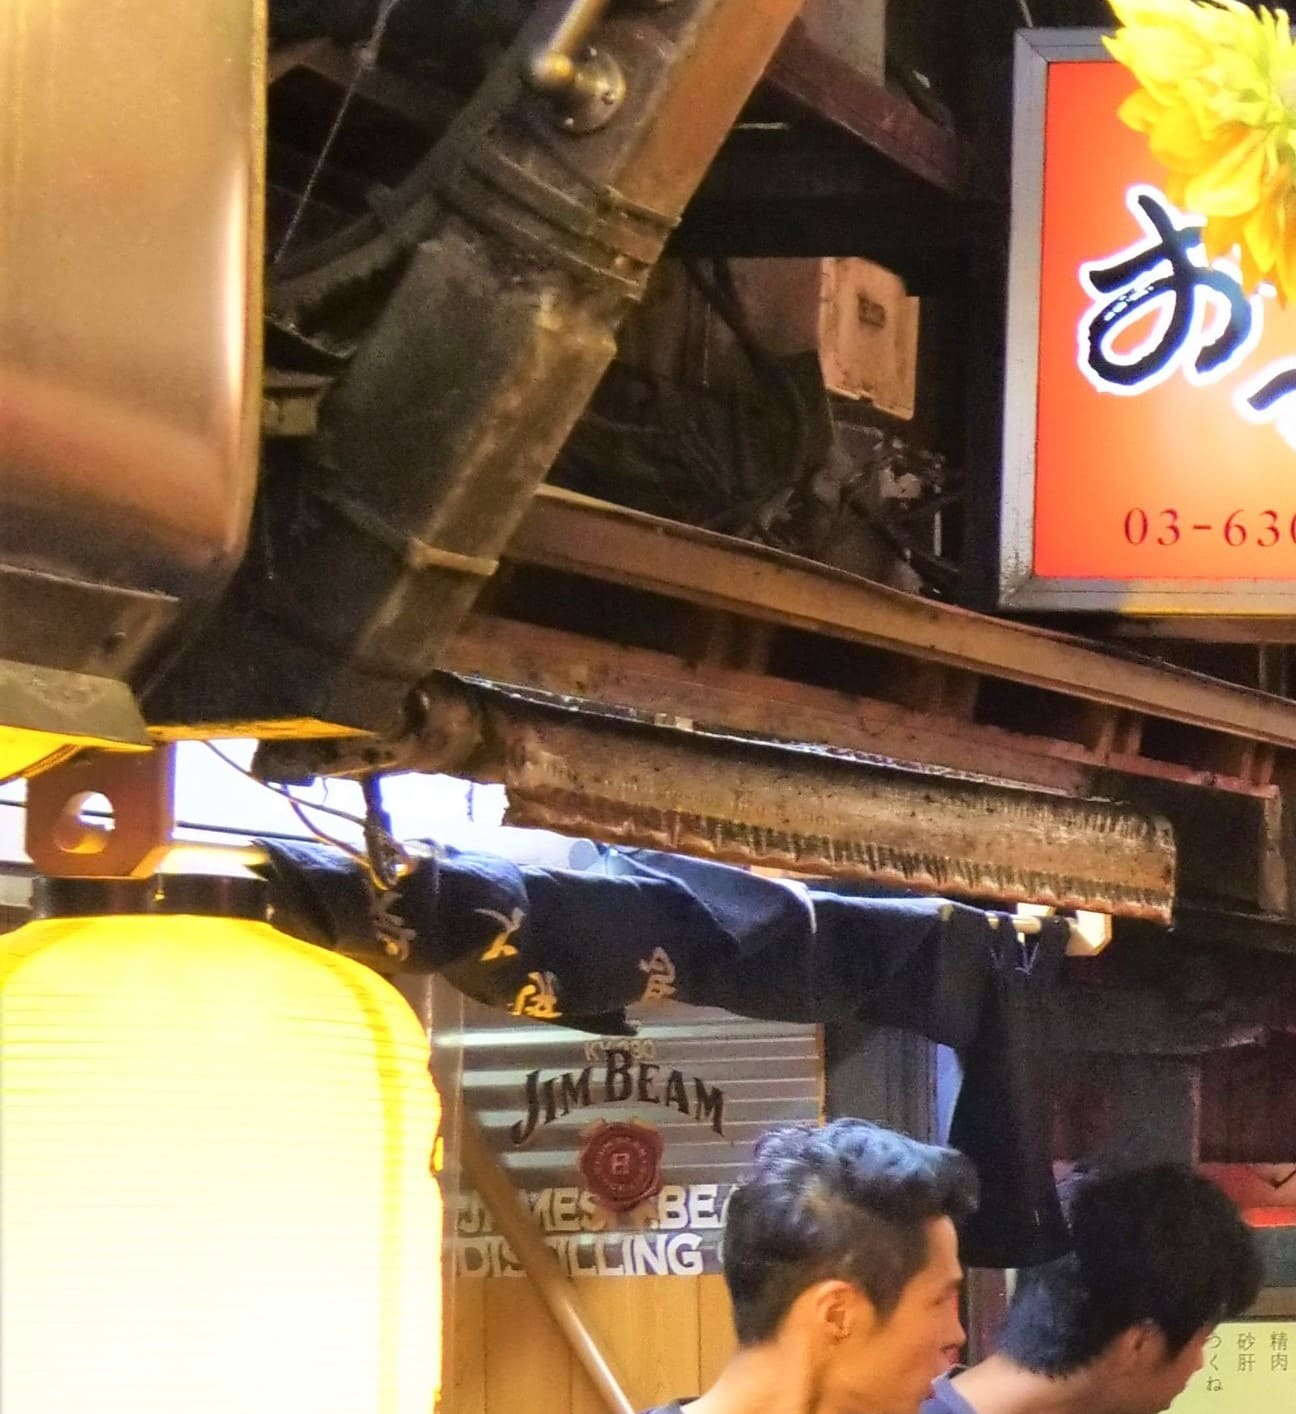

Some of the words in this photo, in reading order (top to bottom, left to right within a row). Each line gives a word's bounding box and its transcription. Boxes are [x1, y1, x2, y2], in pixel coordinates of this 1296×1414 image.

[511, 1069, 593, 1145] JIM
[605, 1046, 726, 1138] BEAM
[456, 1231, 703, 1278] DISLLING
[1205, 1334, 1224, 1393] つくね
[1236, 1331, 1256, 1373] 砂肝
[1269, 1330, 1289, 1372] 精肉
